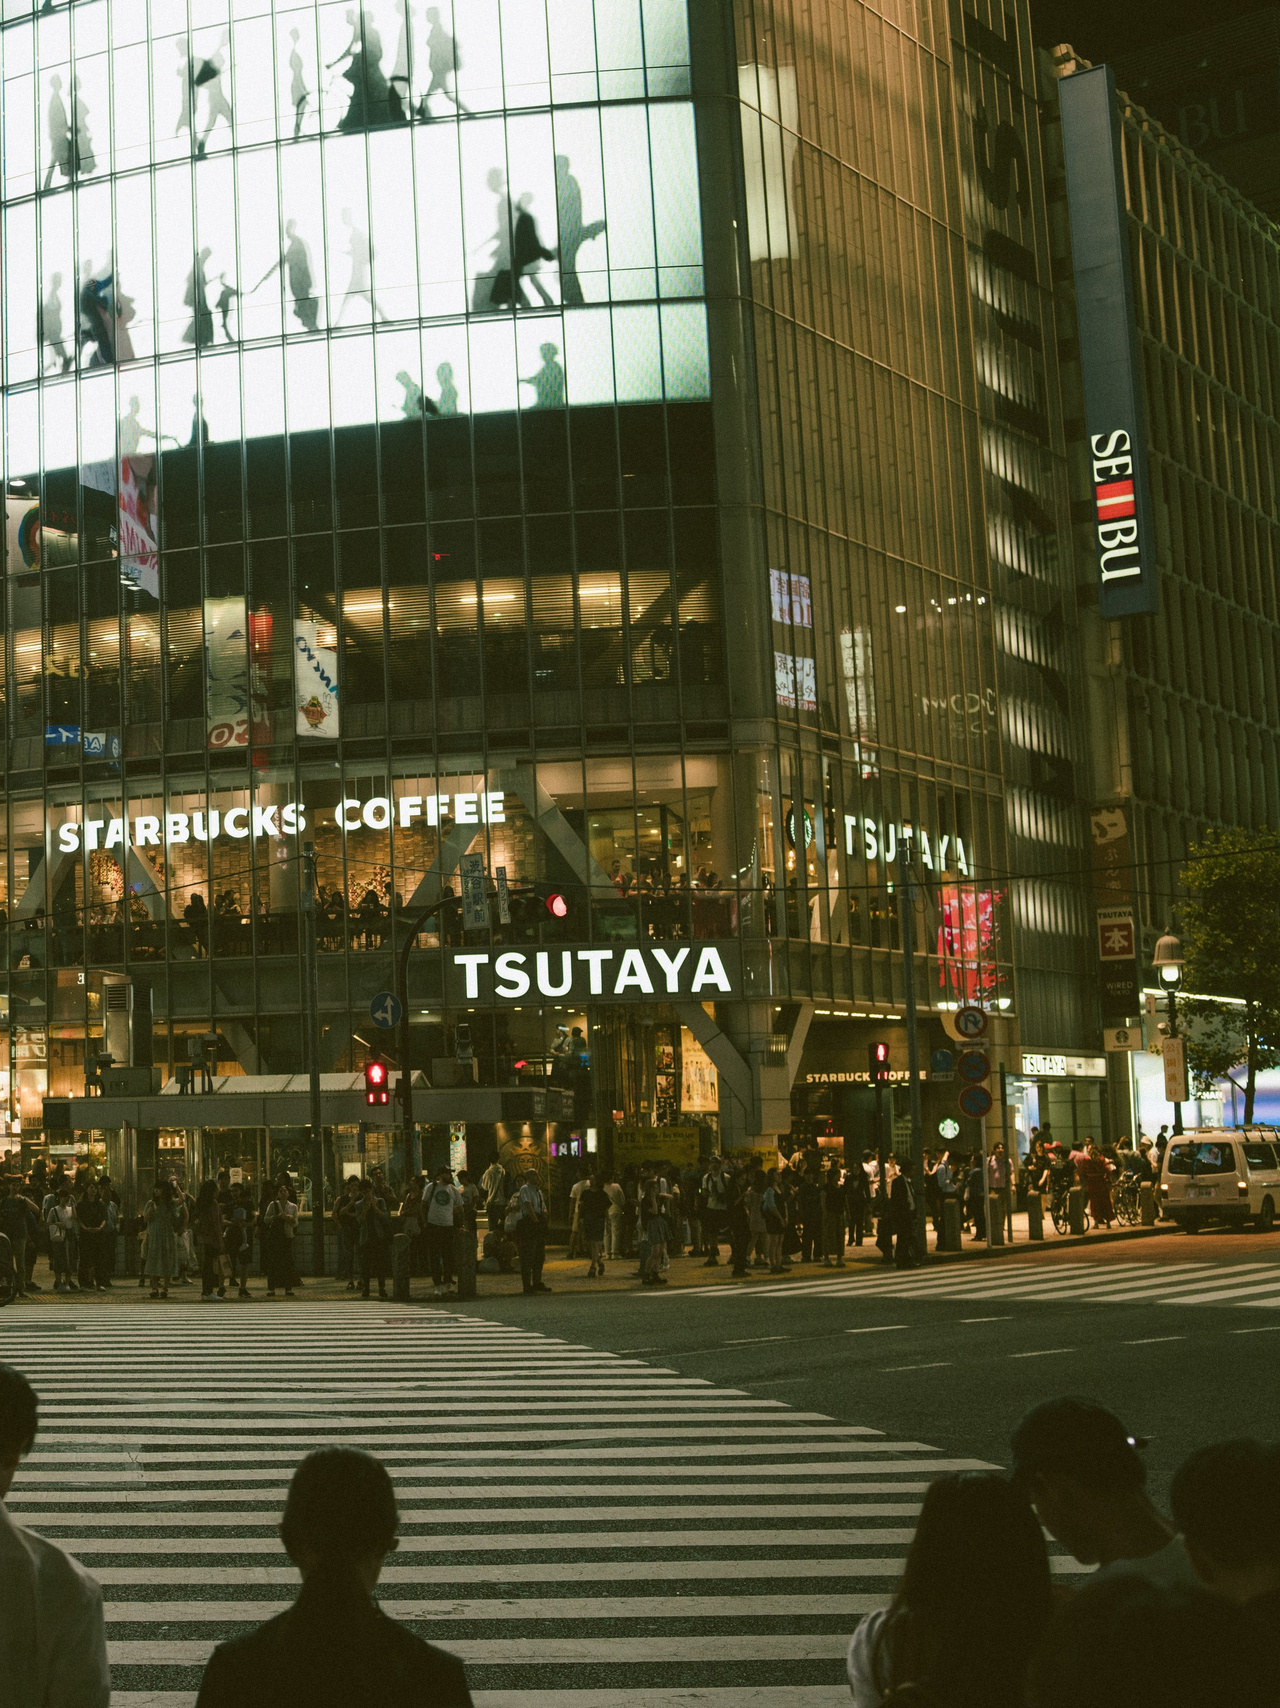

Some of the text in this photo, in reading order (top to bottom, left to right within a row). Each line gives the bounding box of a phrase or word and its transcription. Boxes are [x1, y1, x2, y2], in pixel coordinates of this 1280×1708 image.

[1091, 429, 1141, 584] SEIBU
[59, 792, 506, 853] STARBUCKS COFFEE
[844, 814, 969, 876] TSUTAYA
[469, 860, 485, 923] 渋谷駅前
[1097, 911, 1133, 920] TSUTAYA
[1105, 928, 1128, 952] 本
[454, 947, 732, 999] TSUTAYA
[1106, 981, 1133, 990] WIRED
[806, 1072, 871, 1083] STARBUCK
[887, 1070, 927, 1081] OFFE
[1023, 1056, 1067, 1074] TSUTAYA
